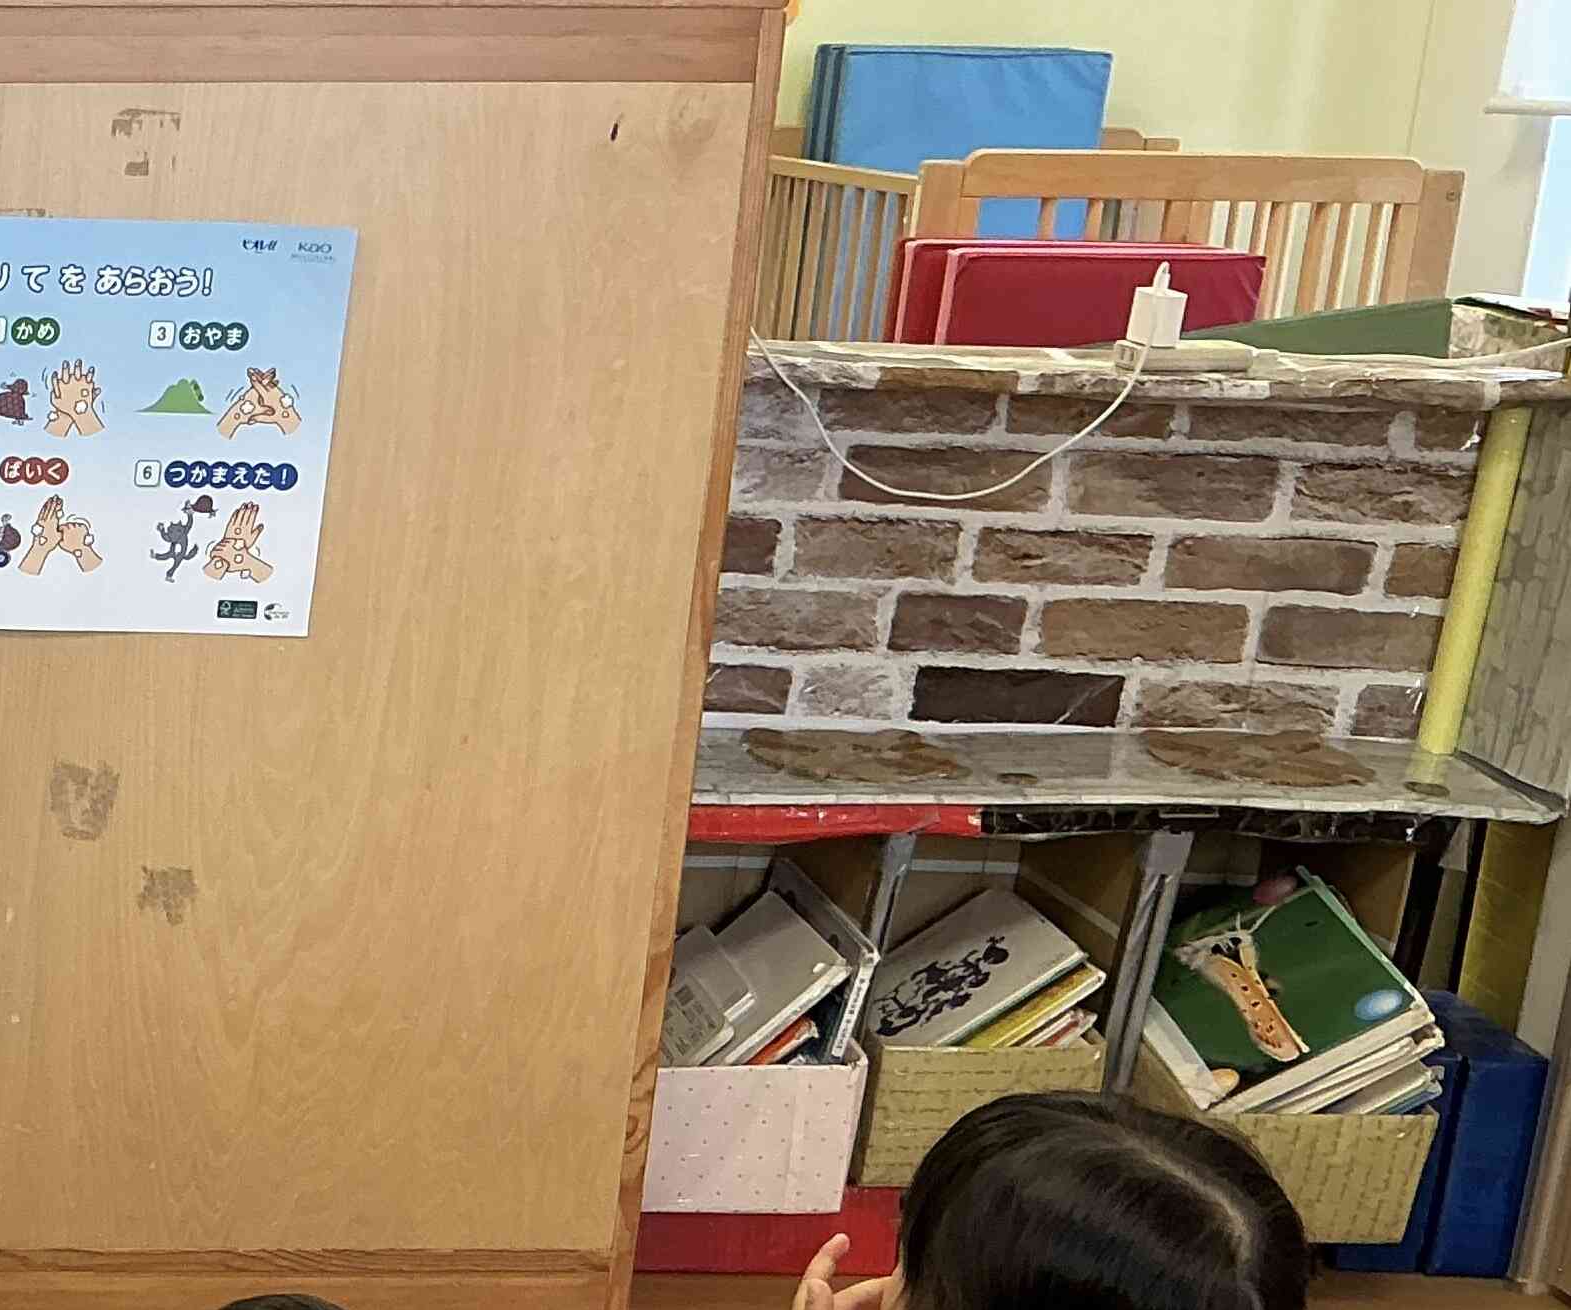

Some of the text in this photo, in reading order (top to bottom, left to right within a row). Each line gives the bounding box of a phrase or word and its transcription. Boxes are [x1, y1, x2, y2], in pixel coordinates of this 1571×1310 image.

[21, 265, 50, 293] て
[60, 264, 86, 294] を
[94, 265, 214, 297] あらおう!
[16, 321, 55, 340] かめ
[183, 326, 243, 346] おやま
[4, 460, 62, 480] ばいく
